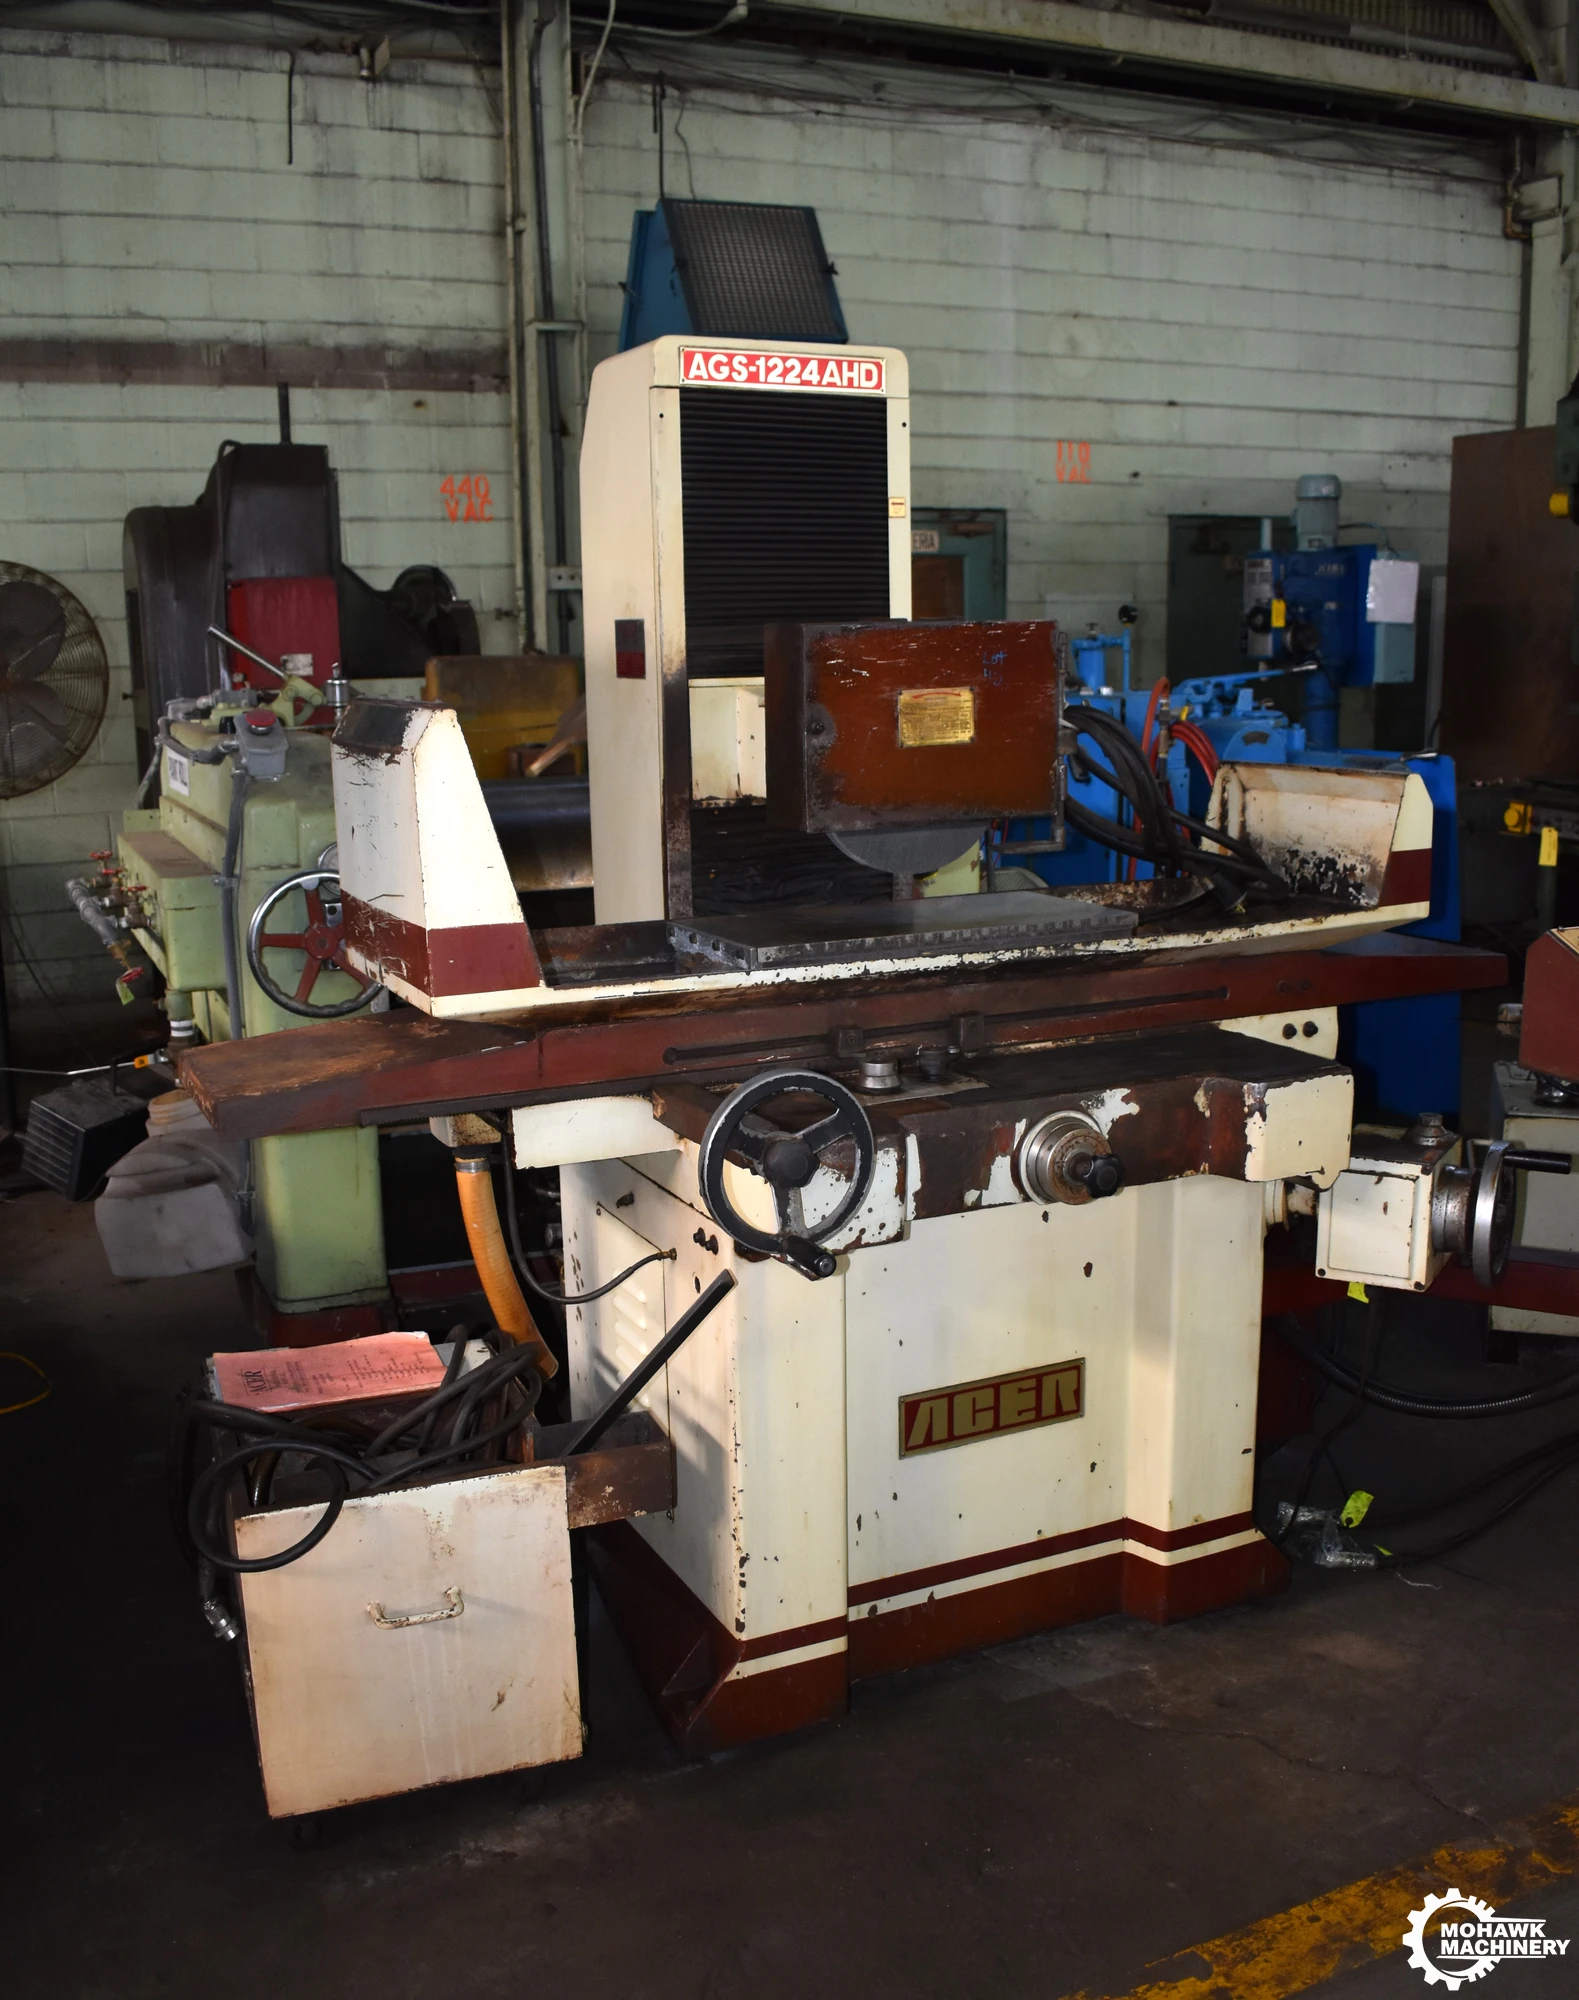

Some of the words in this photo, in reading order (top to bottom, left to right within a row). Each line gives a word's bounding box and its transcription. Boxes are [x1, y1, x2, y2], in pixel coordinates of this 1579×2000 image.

[688, 352, 879, 388] AGS-1224AHD
[440, 474, 489, 499] 440
[444, 498, 494, 523] VAC
[244, 1370, 268, 1393] ACER
[907, 1369, 1078, 1447] ACER
